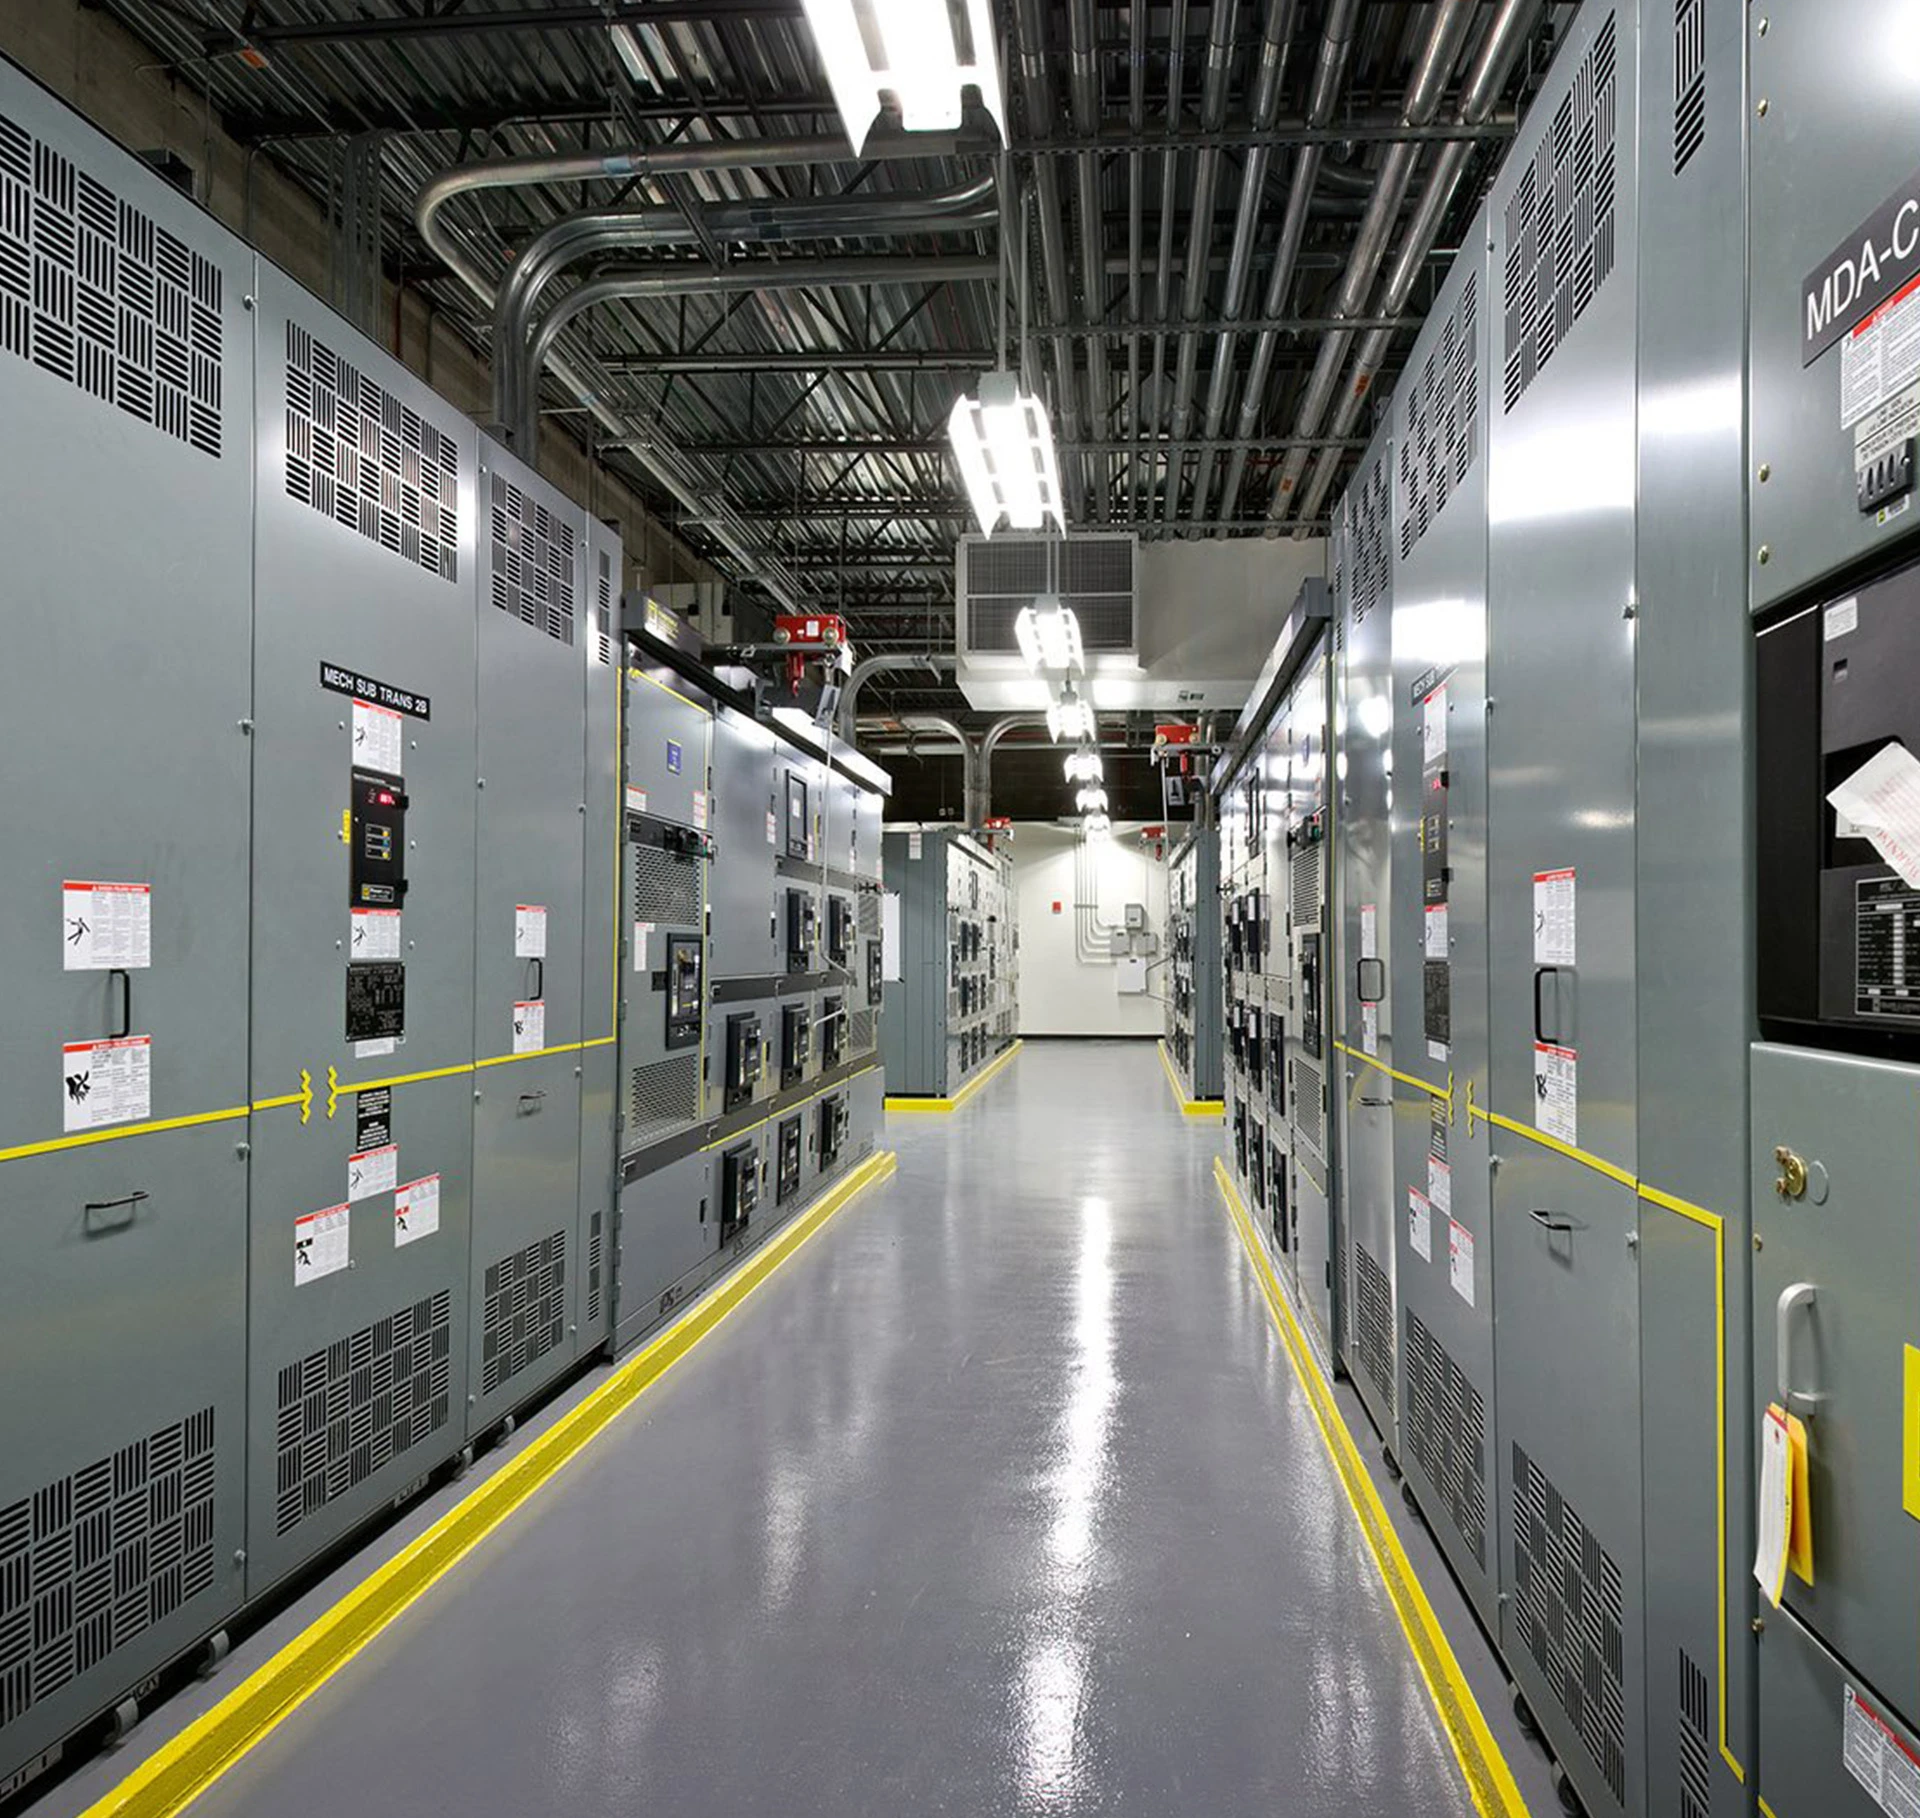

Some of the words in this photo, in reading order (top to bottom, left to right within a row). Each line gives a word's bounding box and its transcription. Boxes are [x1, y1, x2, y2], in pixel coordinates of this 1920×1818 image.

[1807, 198, 1919, 341] MDA-C
[324, 666, 354, 691] MECH
[356, 678, 377, 698] SUB
[379, 686, 413, 710] TRANS
